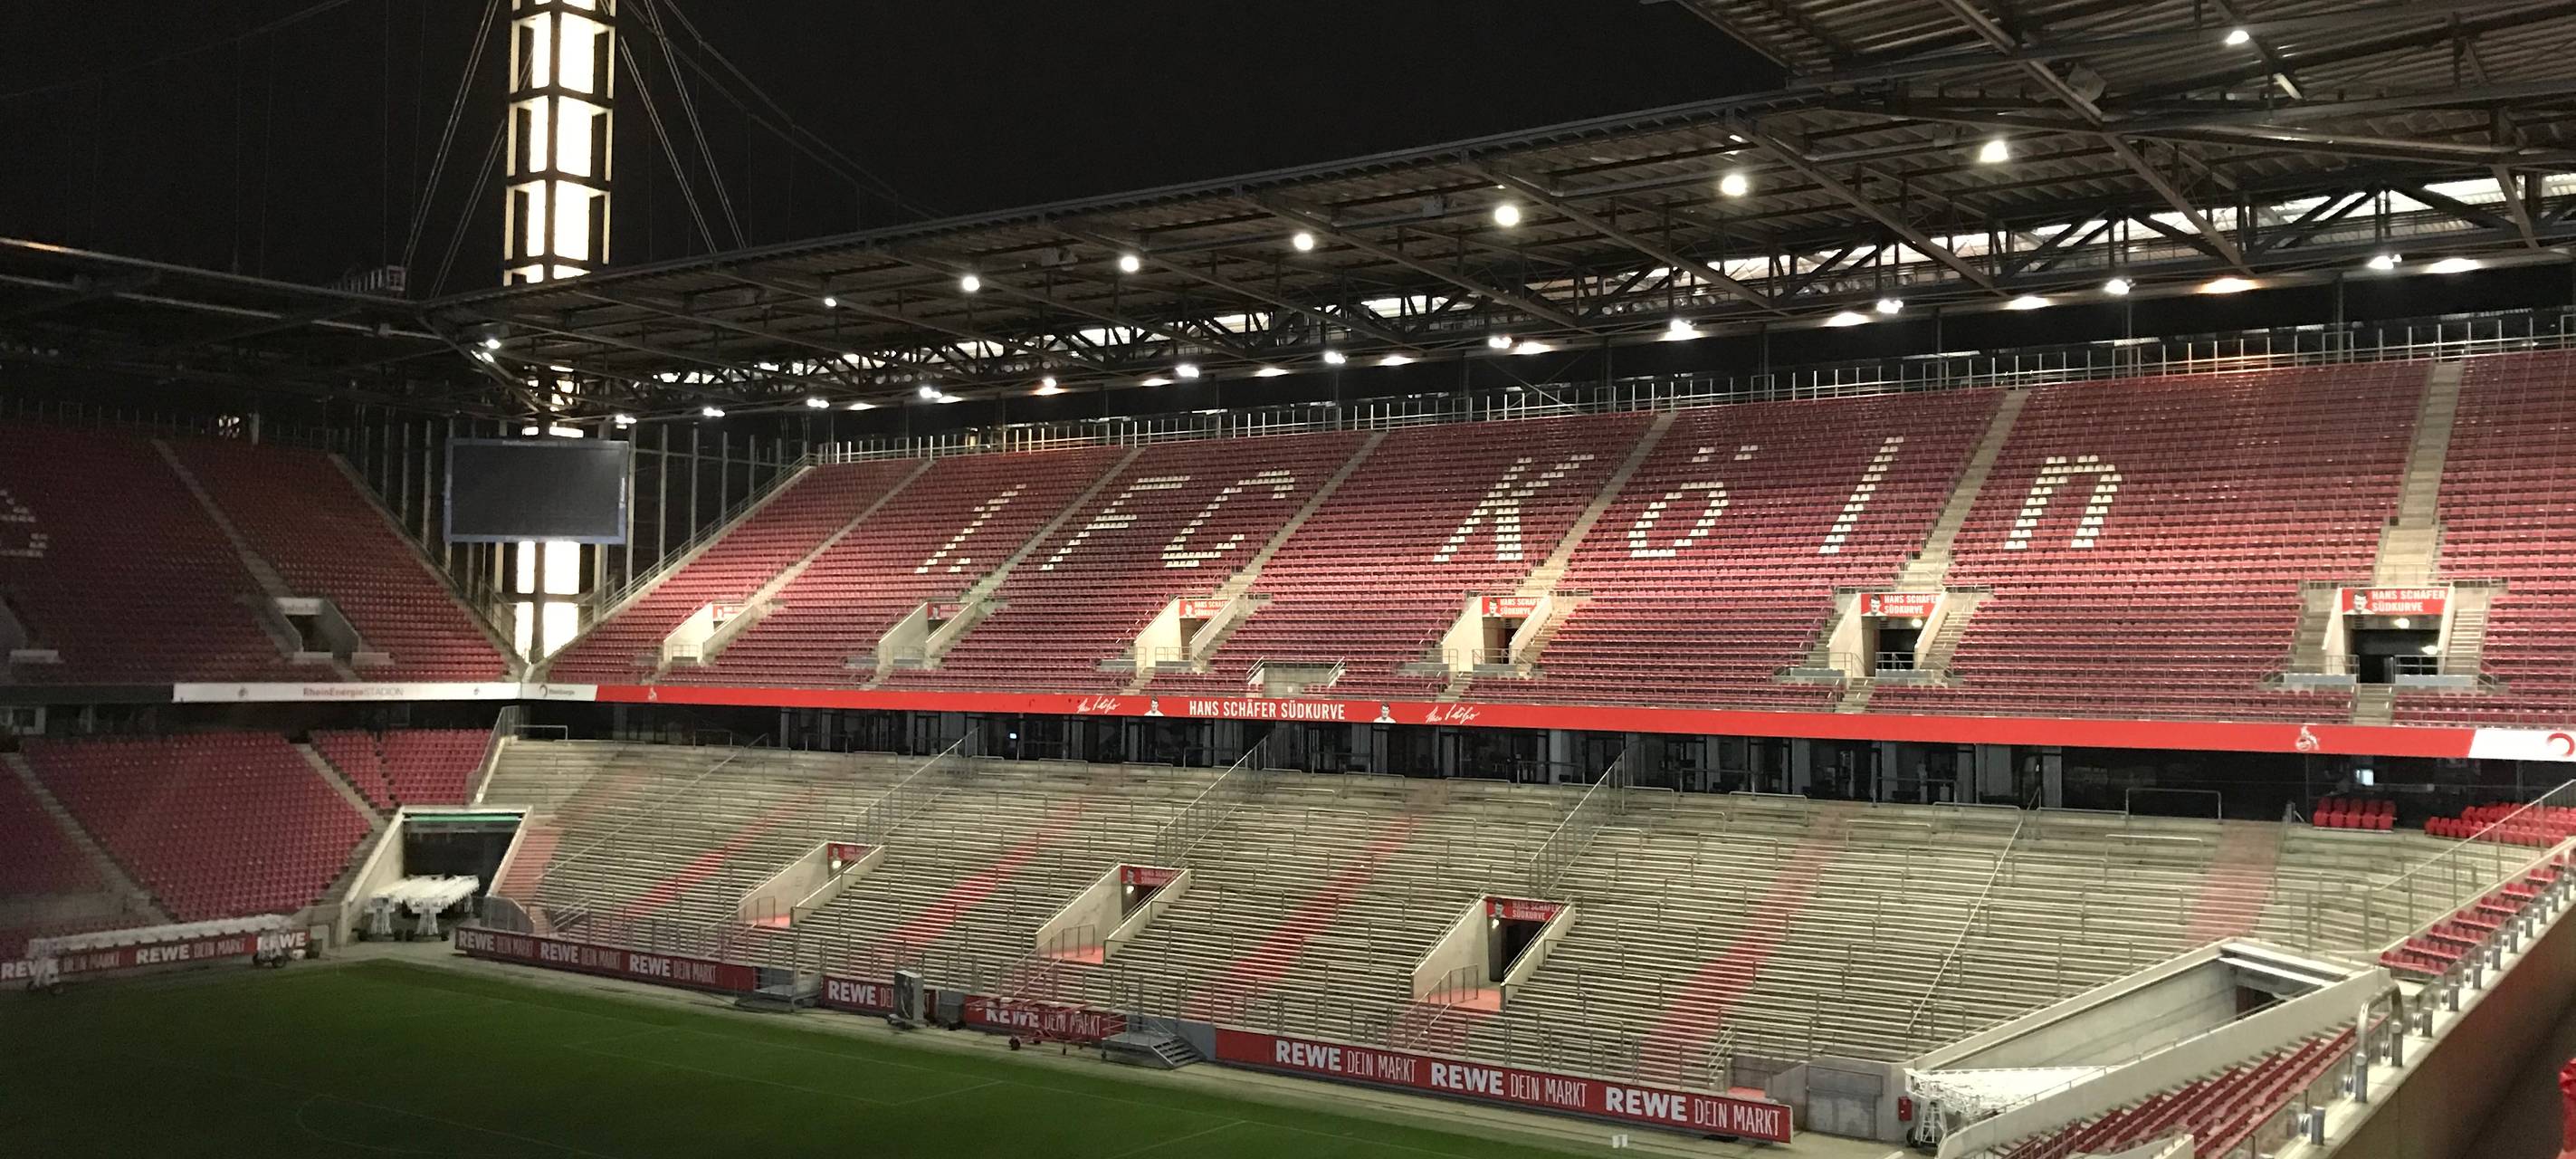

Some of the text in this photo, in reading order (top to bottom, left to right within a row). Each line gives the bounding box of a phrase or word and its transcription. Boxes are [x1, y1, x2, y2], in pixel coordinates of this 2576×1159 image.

[1040, 469, 1295, 571] FC
[1431, 436, 2123, 562] Köln
[1884, 594, 1904, 604] HANS
[2371, 589, 2398, 599] HANS
[1188, 698, 1346, 720] HANS SCHÄFER SÜDKURVE
[136, 943, 191, 965] REWE
[458, 930, 495, 951] REWE
[540, 941, 579, 963] REWE
[629, 953, 672, 977] REWE
[673, 961, 691, 981] DEIN
[692, 963, 717, 984] MARKT
[827, 980, 877, 1006] REWE
[1069, 1012, 1102, 1037] MARKT
[1275, 1039, 1781, 1136] REWE DEIN MARKT REWE DEIN MARKT REWE DEIN MARKT
